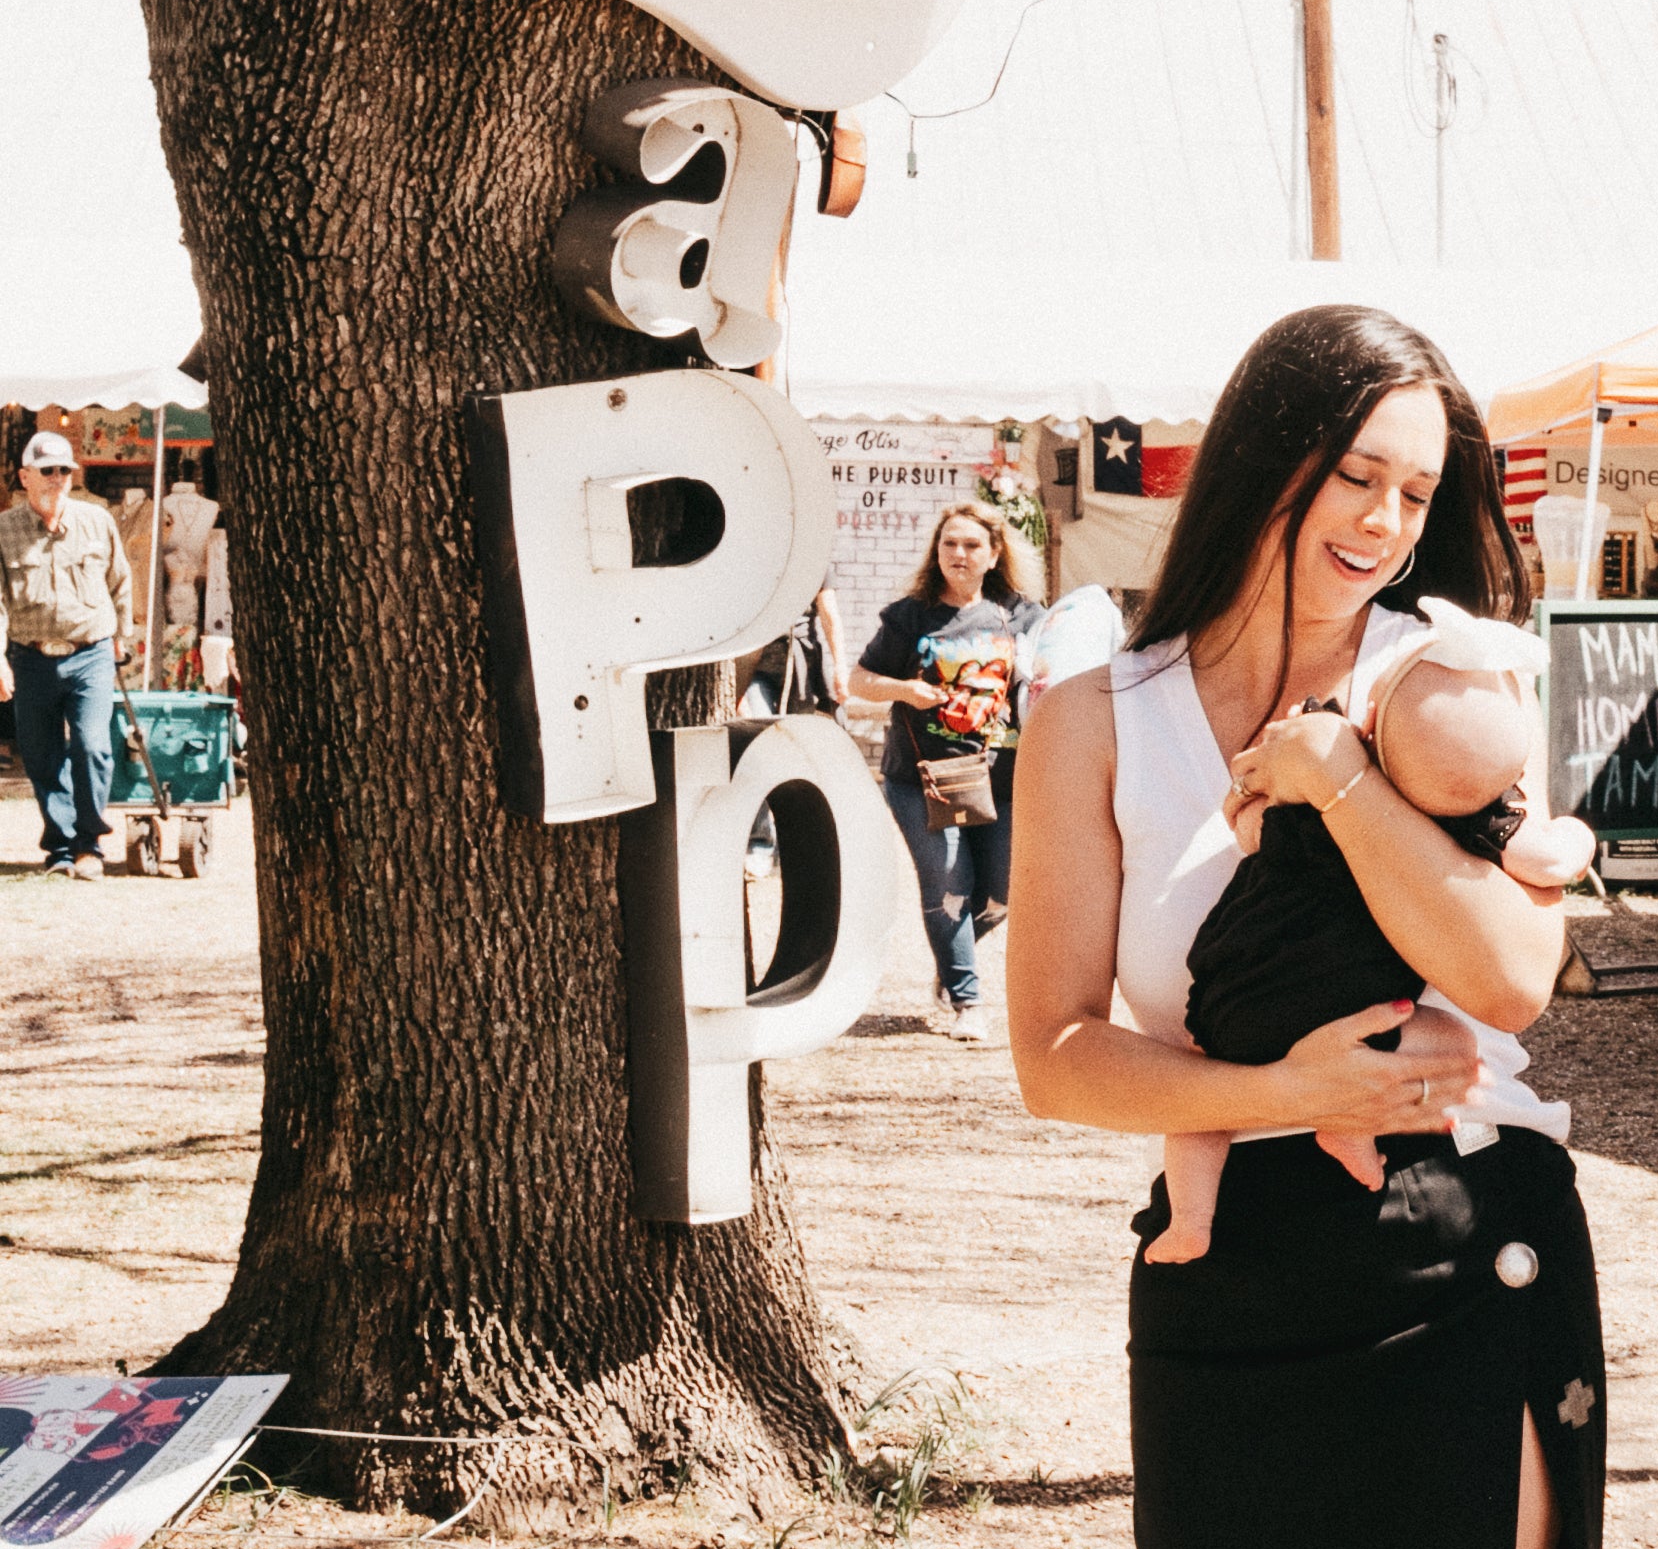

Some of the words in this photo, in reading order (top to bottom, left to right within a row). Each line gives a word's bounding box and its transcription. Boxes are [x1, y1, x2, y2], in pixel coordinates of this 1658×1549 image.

[818, 434, 848, 456] ge
[855, 429, 900, 451] Bliss
[868, 466, 958, 486] PURSUIT
[862, 491, 887, 508] OF
